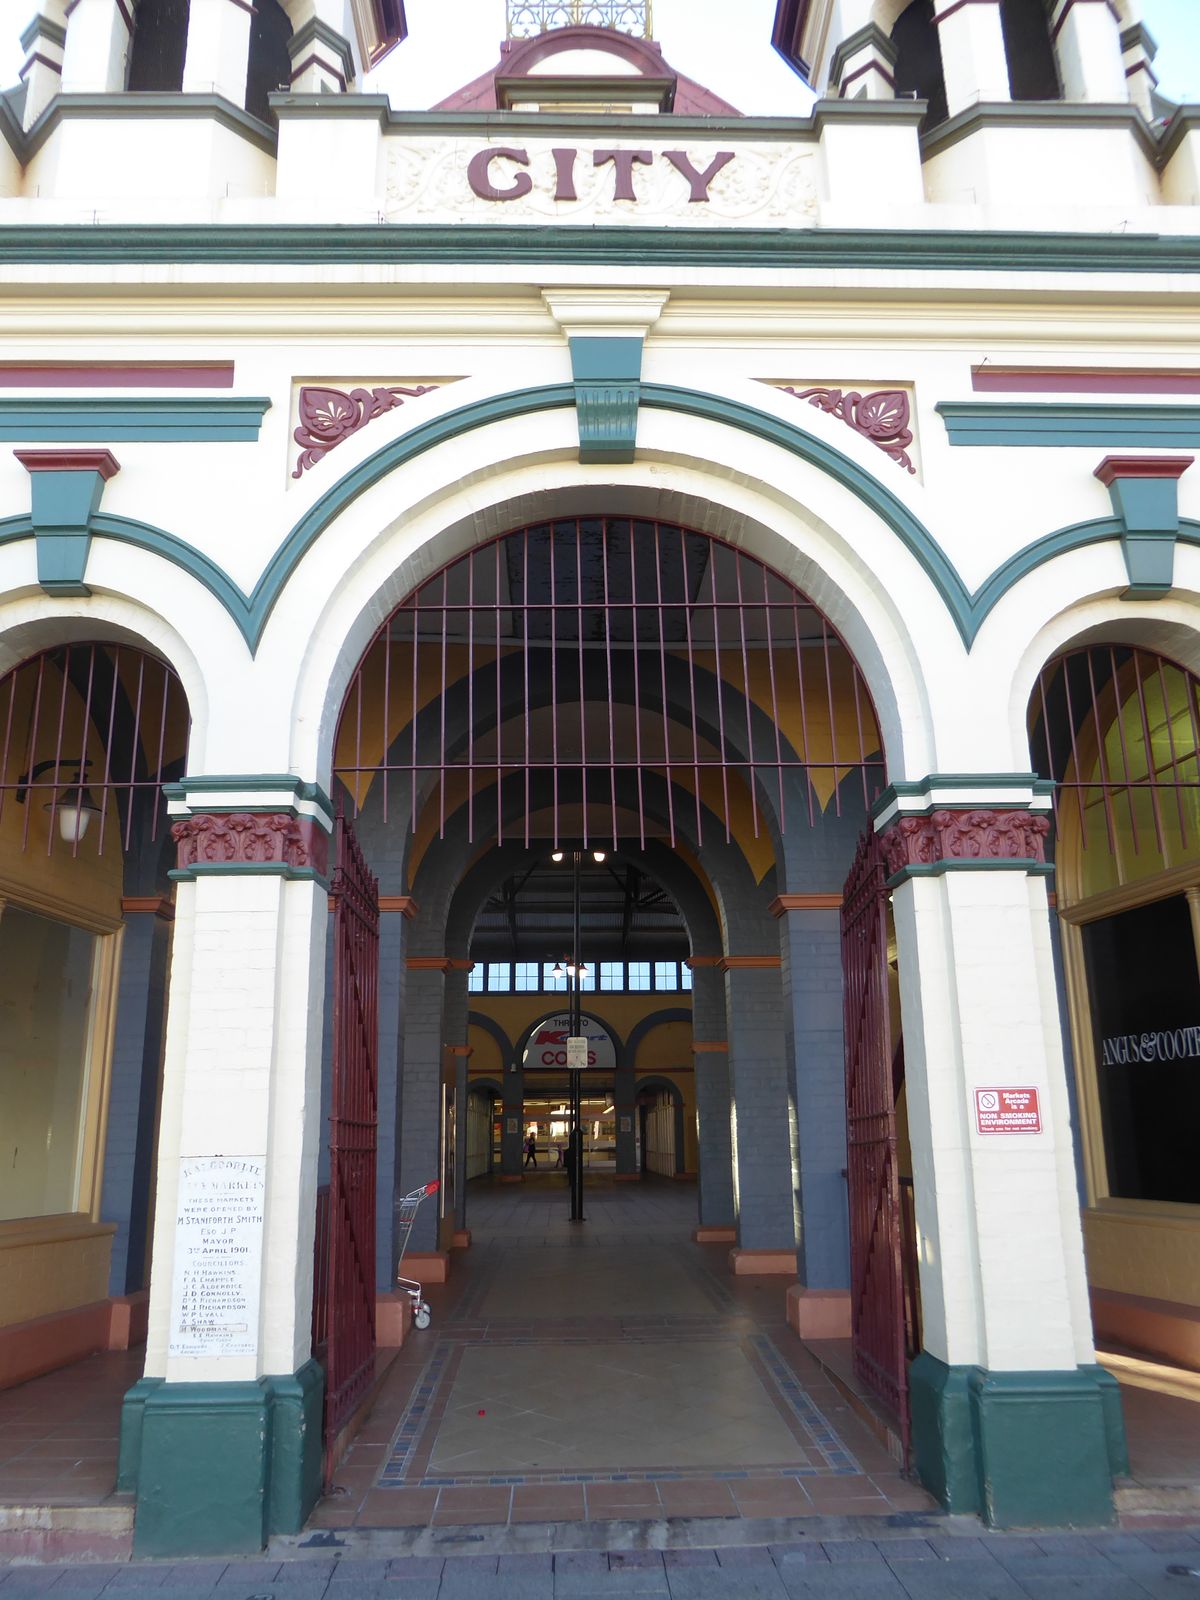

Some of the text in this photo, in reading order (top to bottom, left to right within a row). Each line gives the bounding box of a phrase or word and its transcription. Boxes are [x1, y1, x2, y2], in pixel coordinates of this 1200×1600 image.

[467, 147, 735, 202] CITY
[534, 1031, 607, 1045] Krt
[542, 1051, 596, 1065] COS
[186, 1216, 233, 1225] STANIFORTH
[236, 1215, 262, 1224] SMITH
